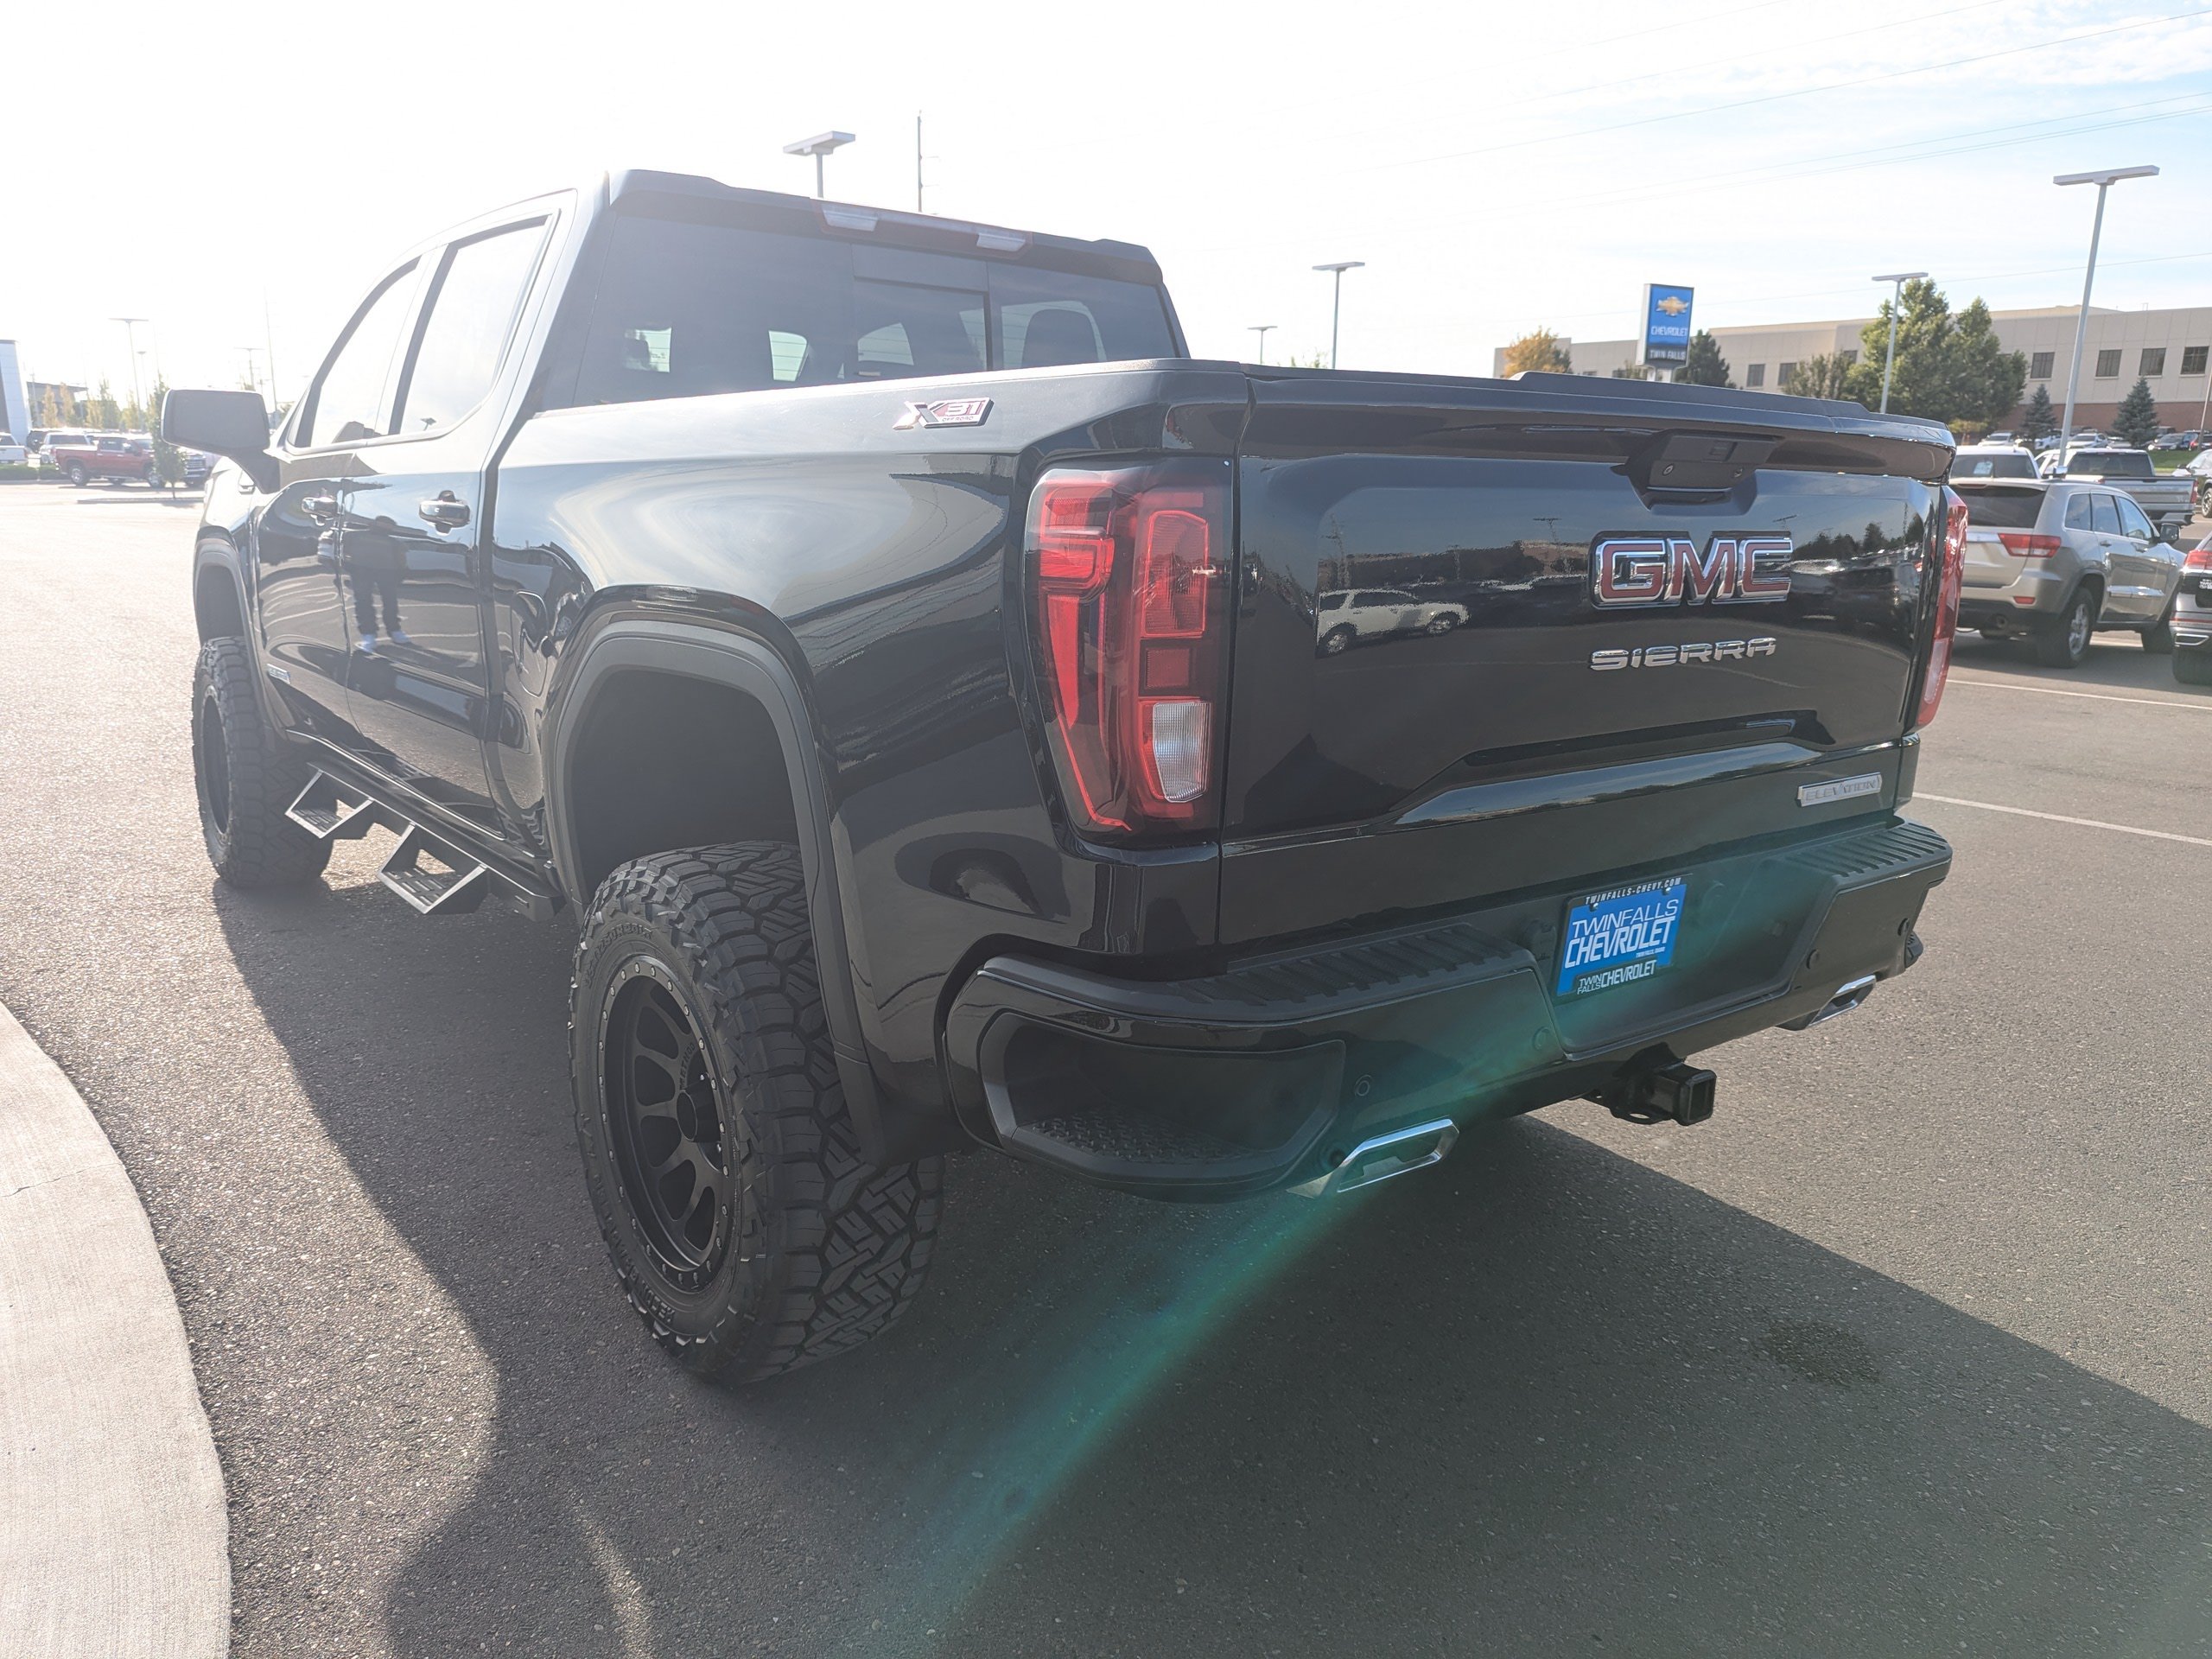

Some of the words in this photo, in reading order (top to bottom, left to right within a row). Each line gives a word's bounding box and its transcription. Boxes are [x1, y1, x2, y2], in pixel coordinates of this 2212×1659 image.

[1650, 326, 1688, 337] CHEVROLET
[1649, 349, 1666, 359] TWIN
[893, 398, 987, 429] X31
[1595, 537, 1794, 604] GMC
[1590, 637, 1777, 671] SIERRA
[1564, 916, 1675, 969] CHEVROLET
[1579, 973, 1603, 988] TWIN
[1600, 959, 1657, 988] CHEVROLET
[1577, 982, 1601, 995] FALLS
